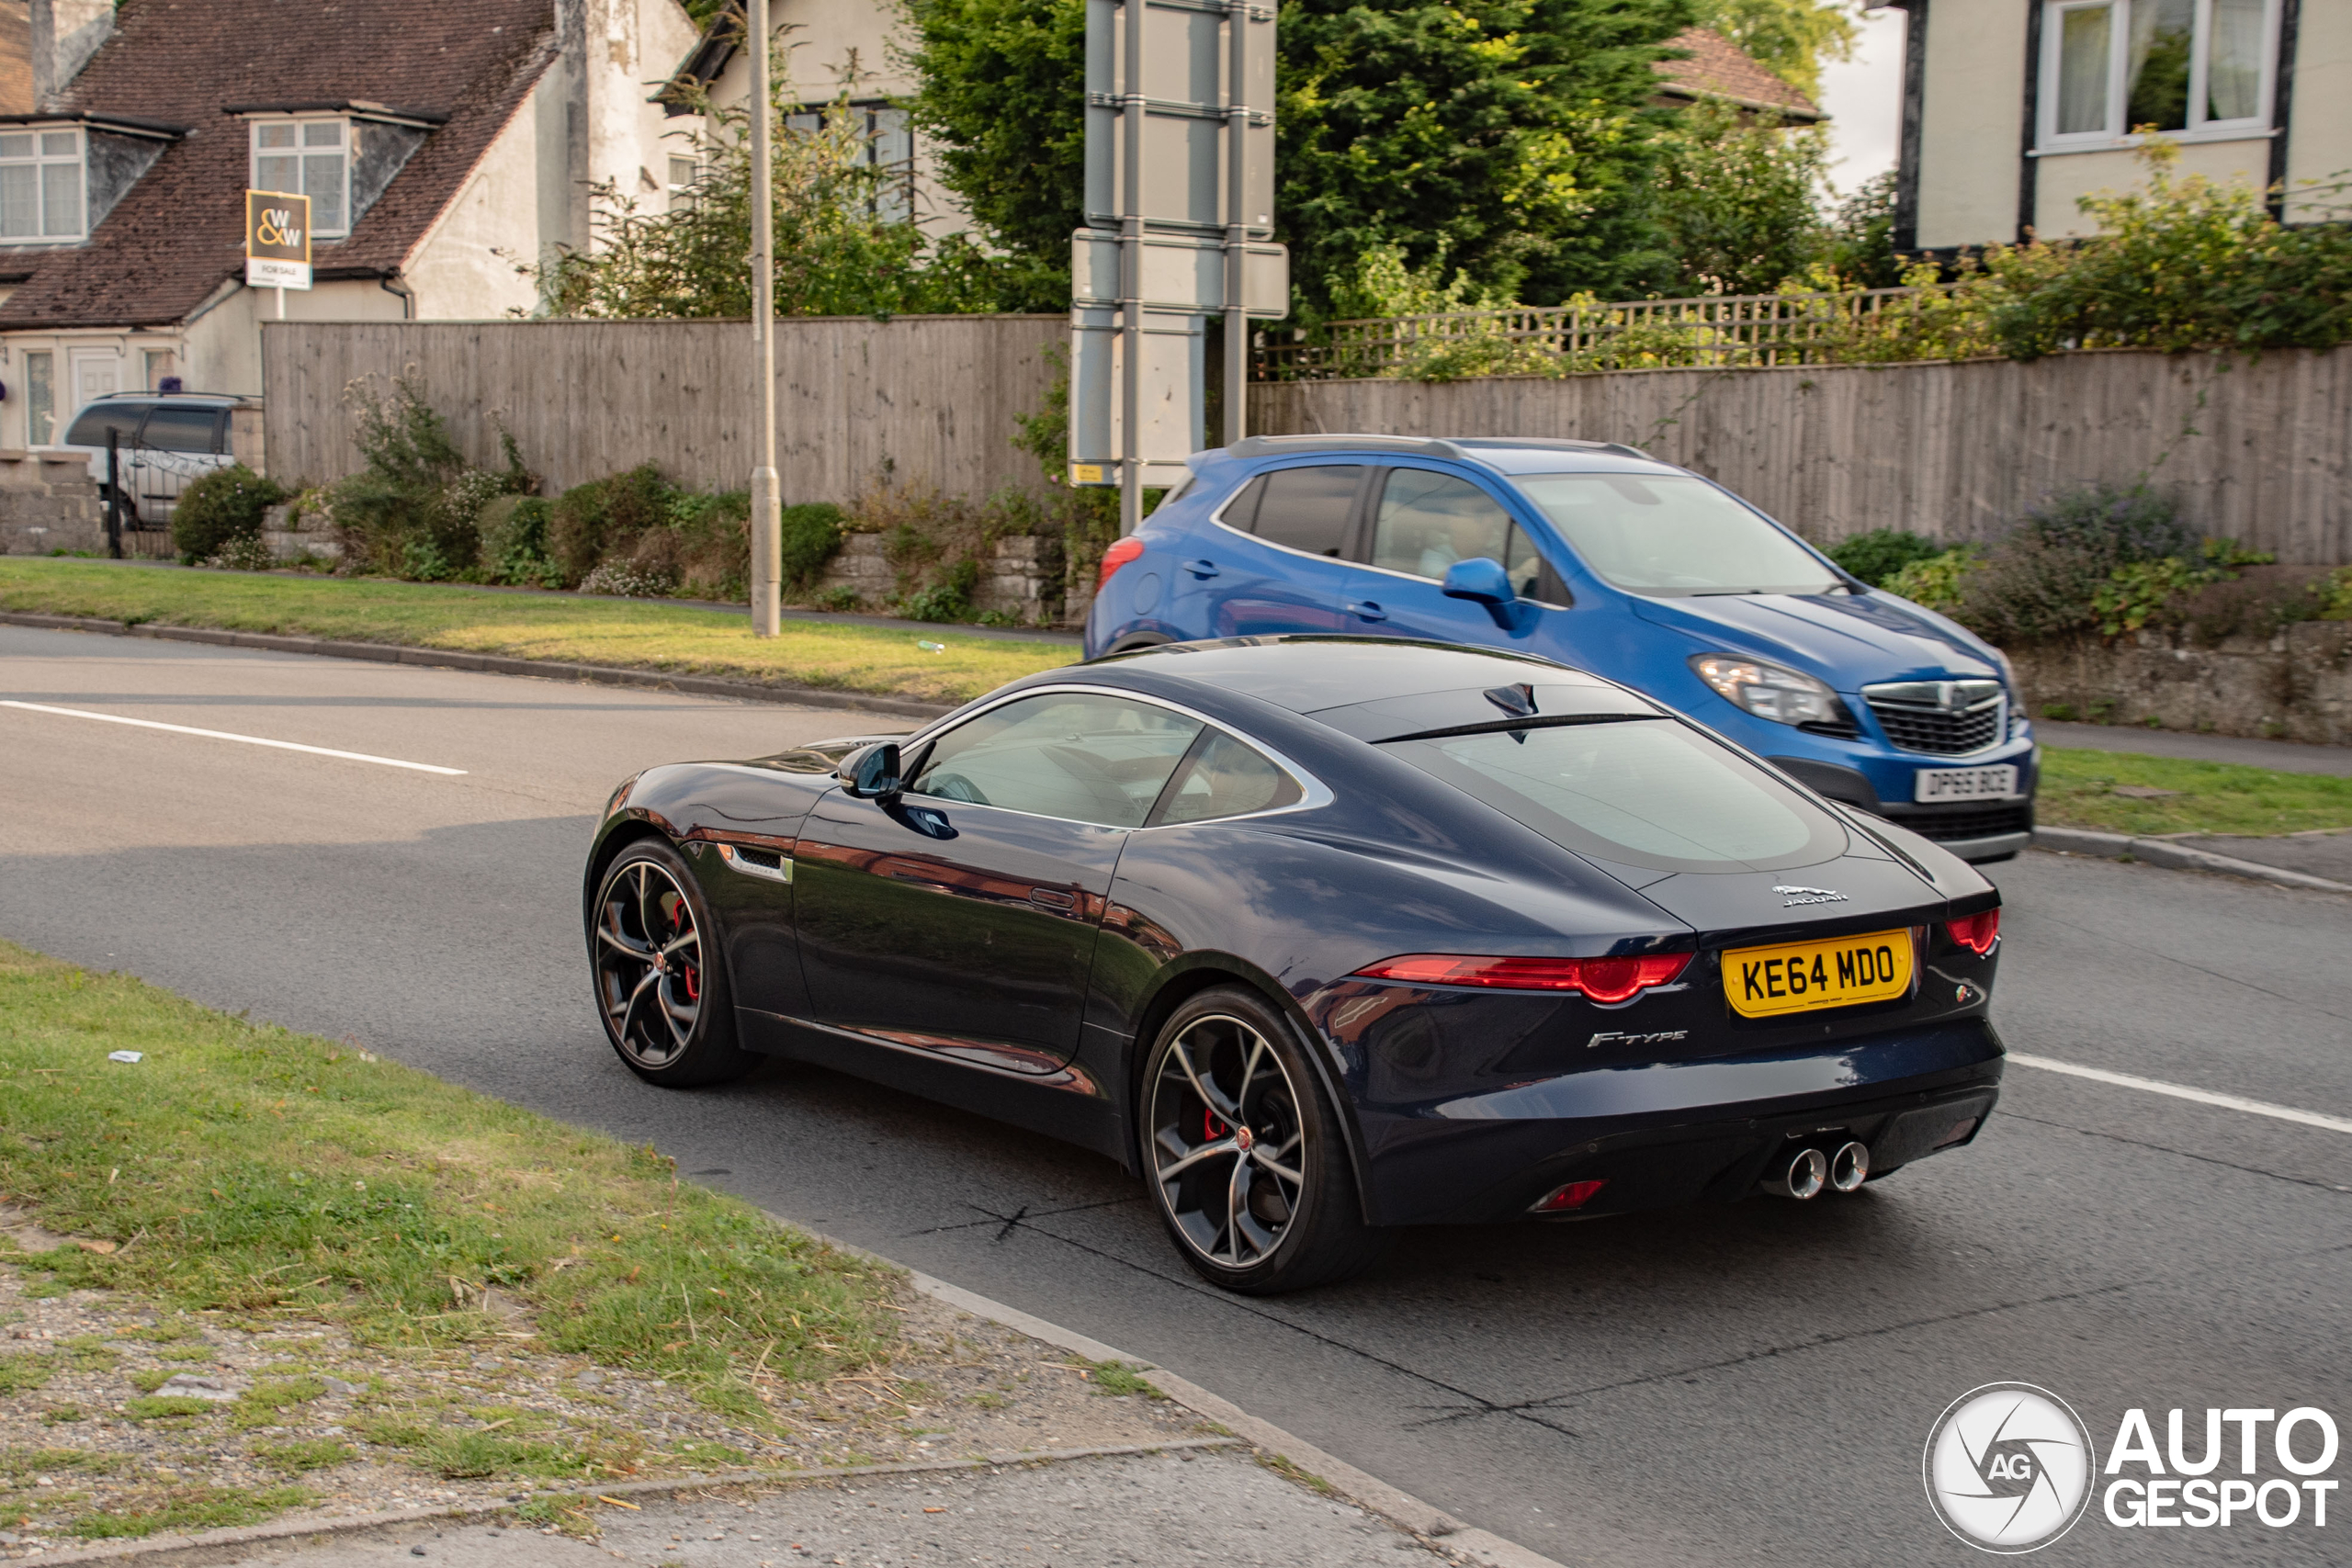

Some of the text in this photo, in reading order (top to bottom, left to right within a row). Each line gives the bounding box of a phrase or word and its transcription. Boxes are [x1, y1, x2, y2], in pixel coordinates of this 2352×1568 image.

[262, 265, 297, 276] FOR SALE
[745, 864, 774, 874] JAGUAR
[1783, 894, 1849, 908] JAGUAR
[1742, 945, 1894, 1001] KE64 MDO
[1587, 1030, 1689, 1048] F-TYPE
